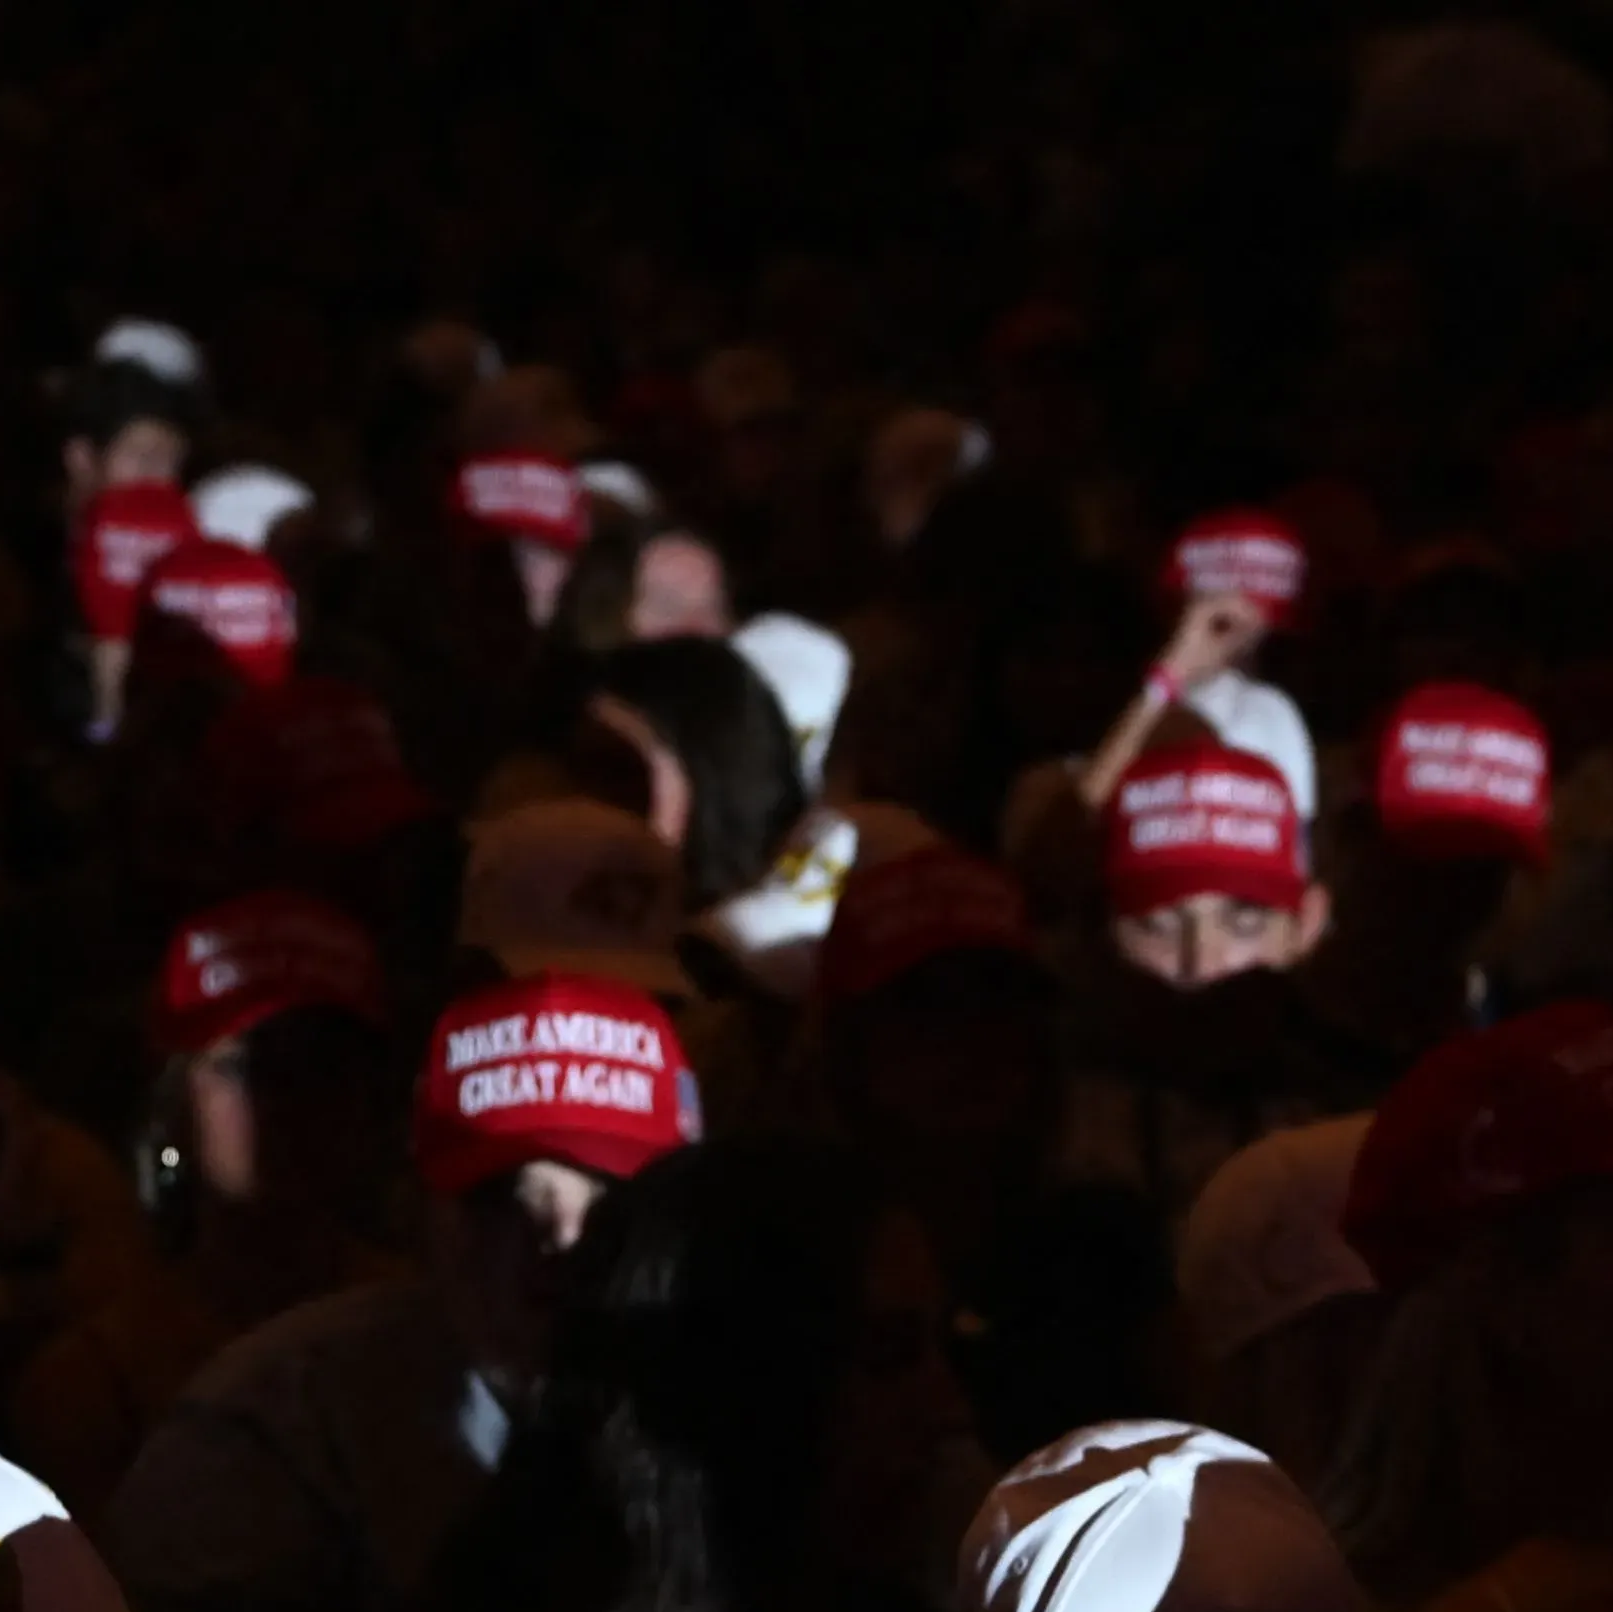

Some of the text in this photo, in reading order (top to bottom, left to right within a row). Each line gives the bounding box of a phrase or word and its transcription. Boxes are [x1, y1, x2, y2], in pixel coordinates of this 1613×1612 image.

[446, 1010, 665, 1074] MAKE AMERICA
[459, 1060, 561, 1117] GREAT
